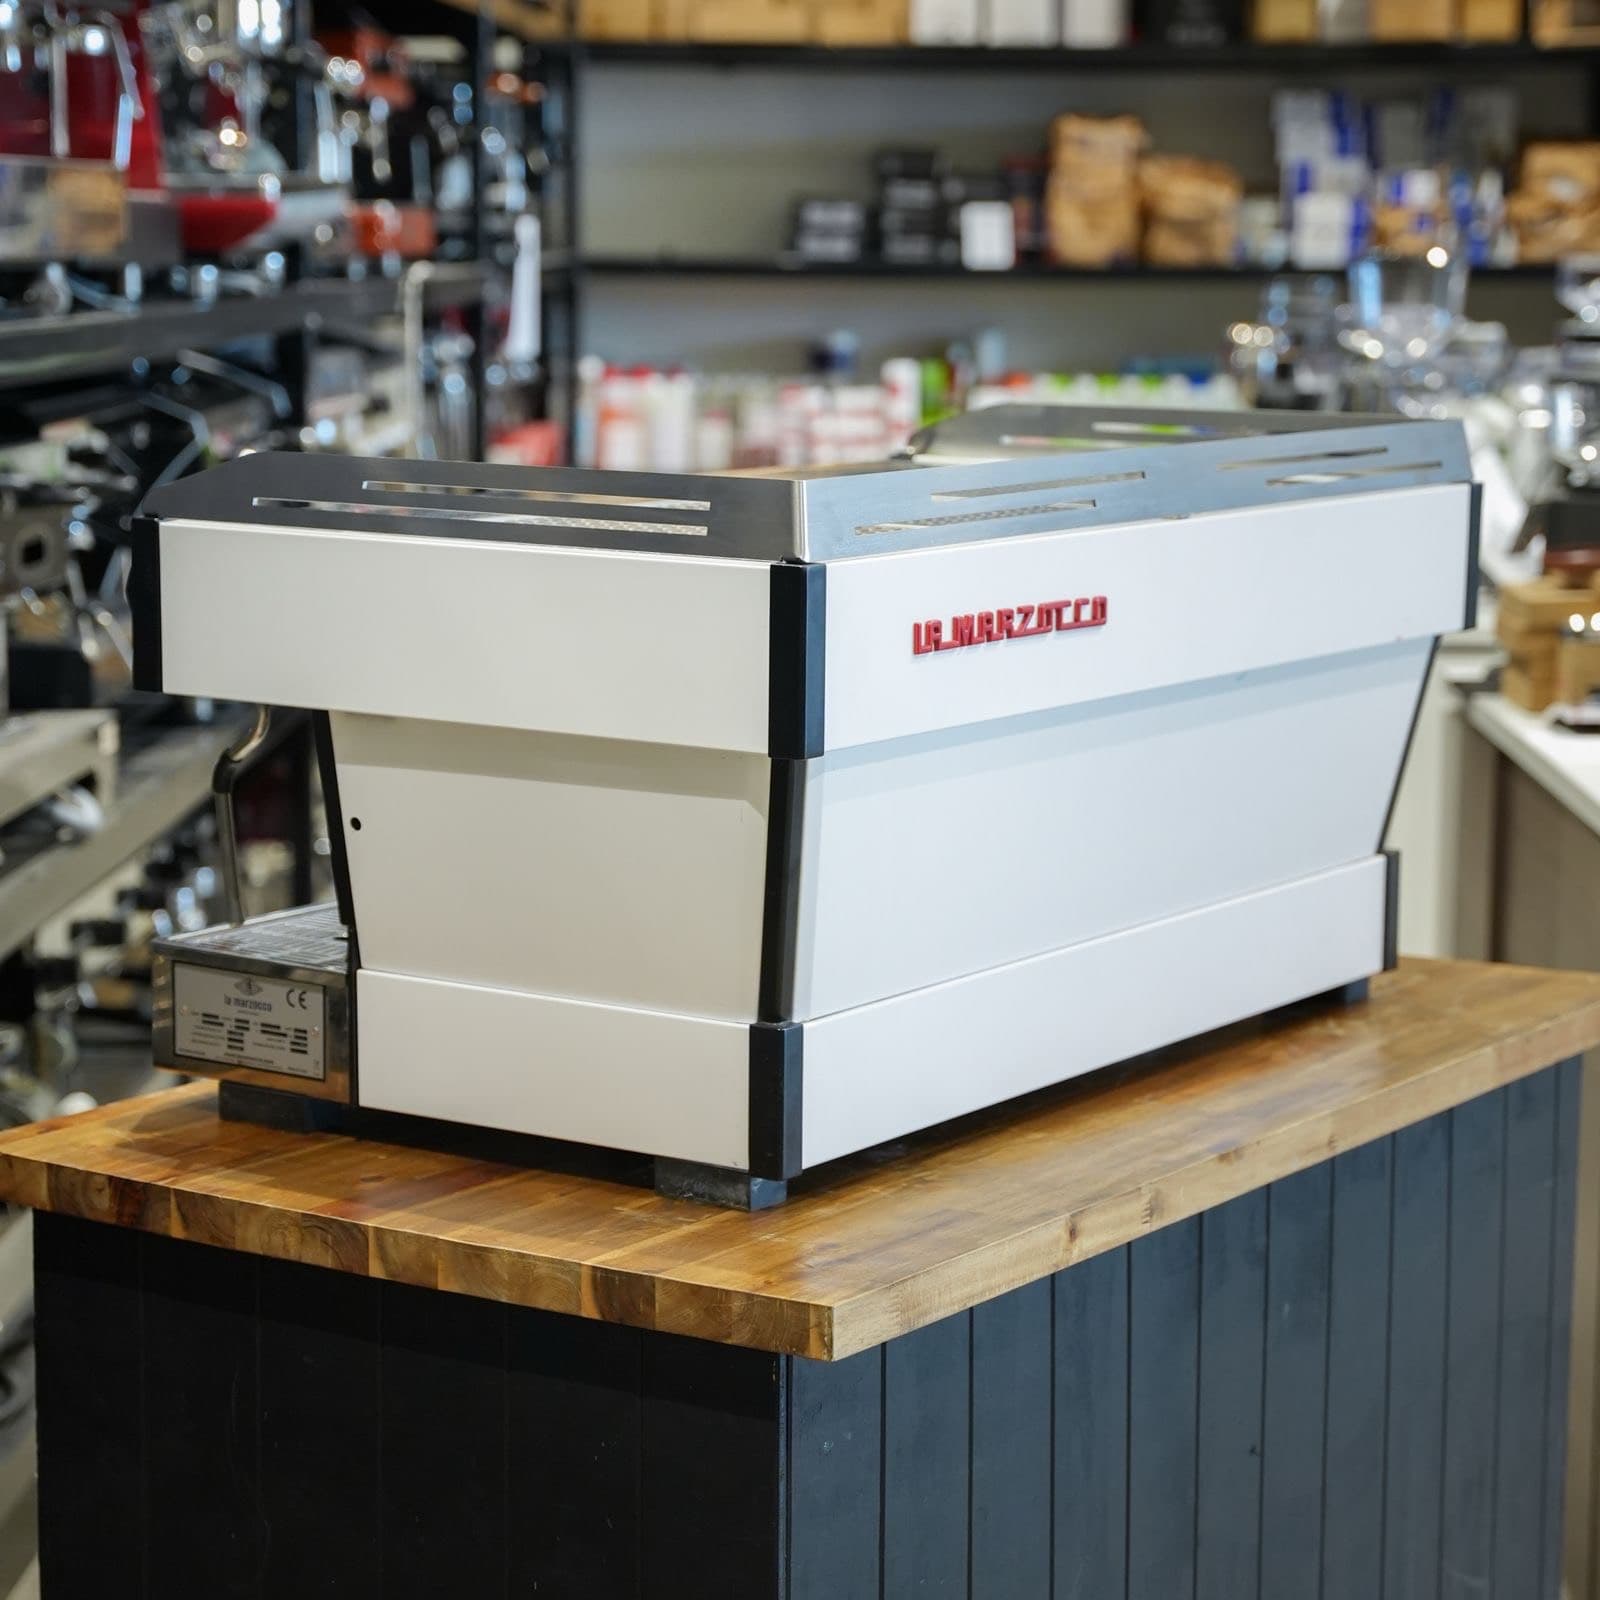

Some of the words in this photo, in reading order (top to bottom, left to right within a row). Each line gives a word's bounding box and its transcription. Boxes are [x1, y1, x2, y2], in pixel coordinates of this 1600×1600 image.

[912, 619, 942, 655] LA
[952, 595, 1108, 647] MARZOCCO
[223, 993, 232, 1006] la
[233, 997, 272, 1013] marzocco
[286, 988, 308, 1010] CE
